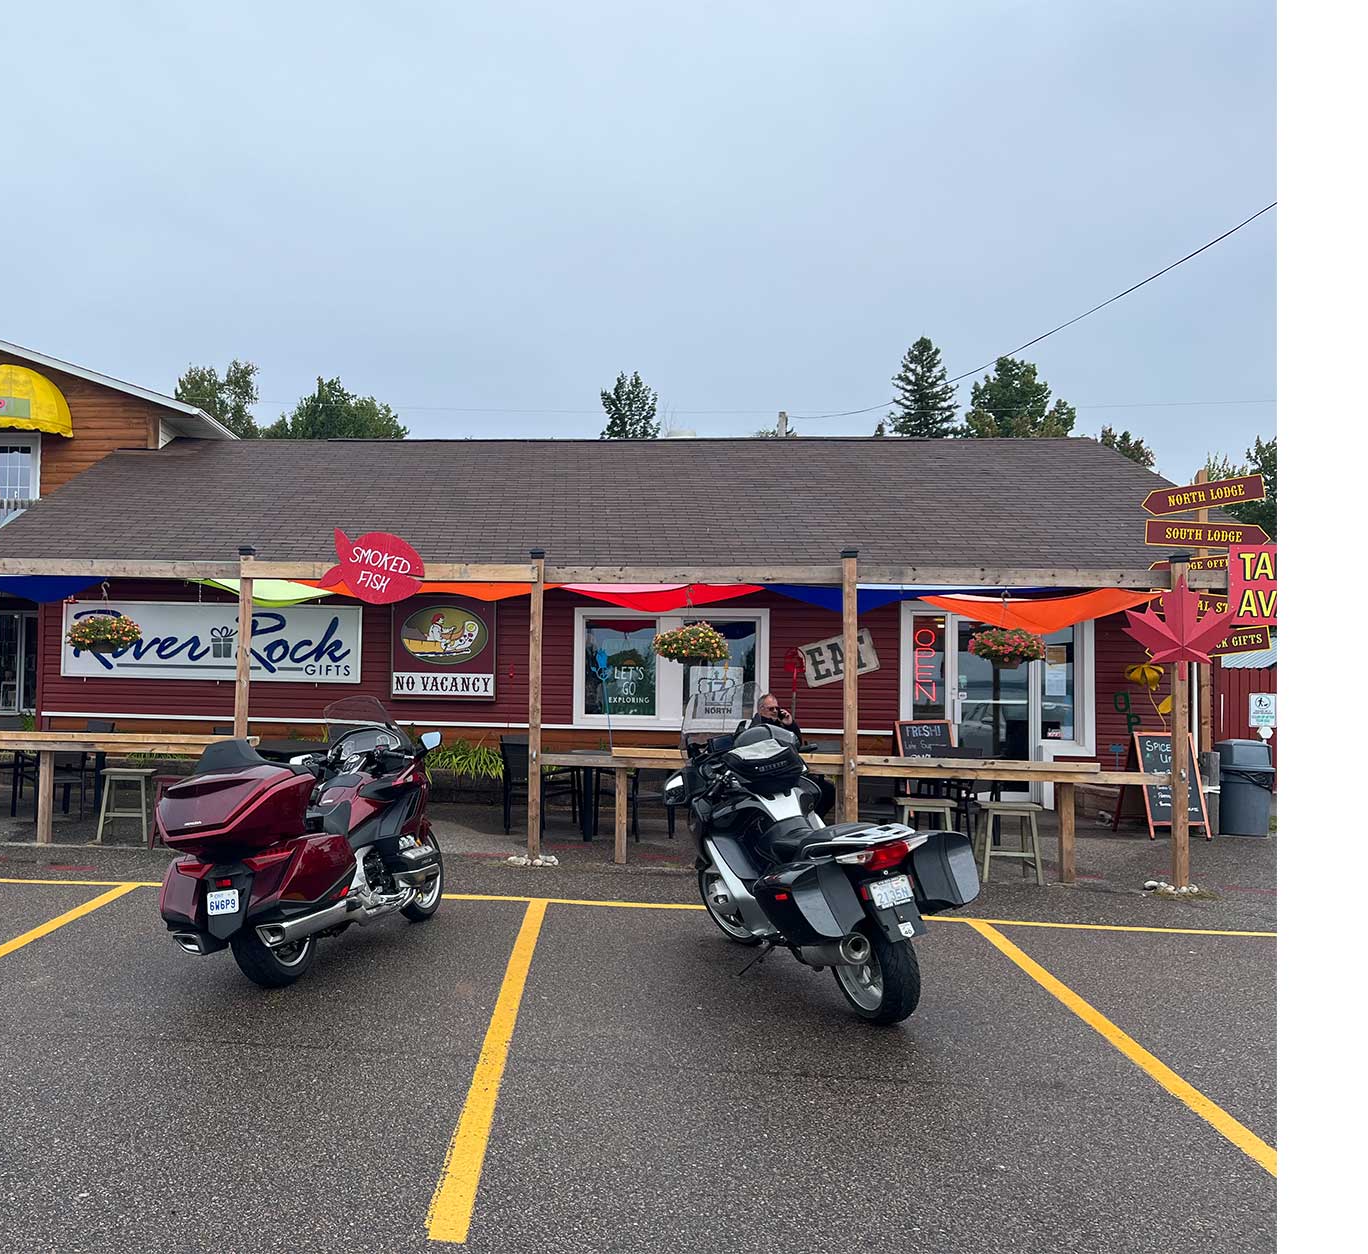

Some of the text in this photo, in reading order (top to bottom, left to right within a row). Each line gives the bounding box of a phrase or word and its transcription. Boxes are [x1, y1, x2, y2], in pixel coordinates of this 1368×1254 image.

[1168, 484, 1245, 506] NORTH LODGE
[1165, 527, 1243, 543] SOUTH LODGE
[349, 546, 411, 593] SMOKED FISH
[1239, 552, 1277, 581] TA
[1238, 589, 1277, 617] AV
[1232, 633, 1263, 647] GIFTS
[304, 664, 351, 677] GIFTS
[915, 628, 936, 702] OPEN
[614, 666, 644, 680] LET'S
[395, 675, 491, 693] NO VACANCY
[622, 681, 636, 695] GO
[608, 696, 650, 704] EXPLORING
[905, 725, 941, 737] FRESH!
[209, 898, 236, 911] 6W6P9
